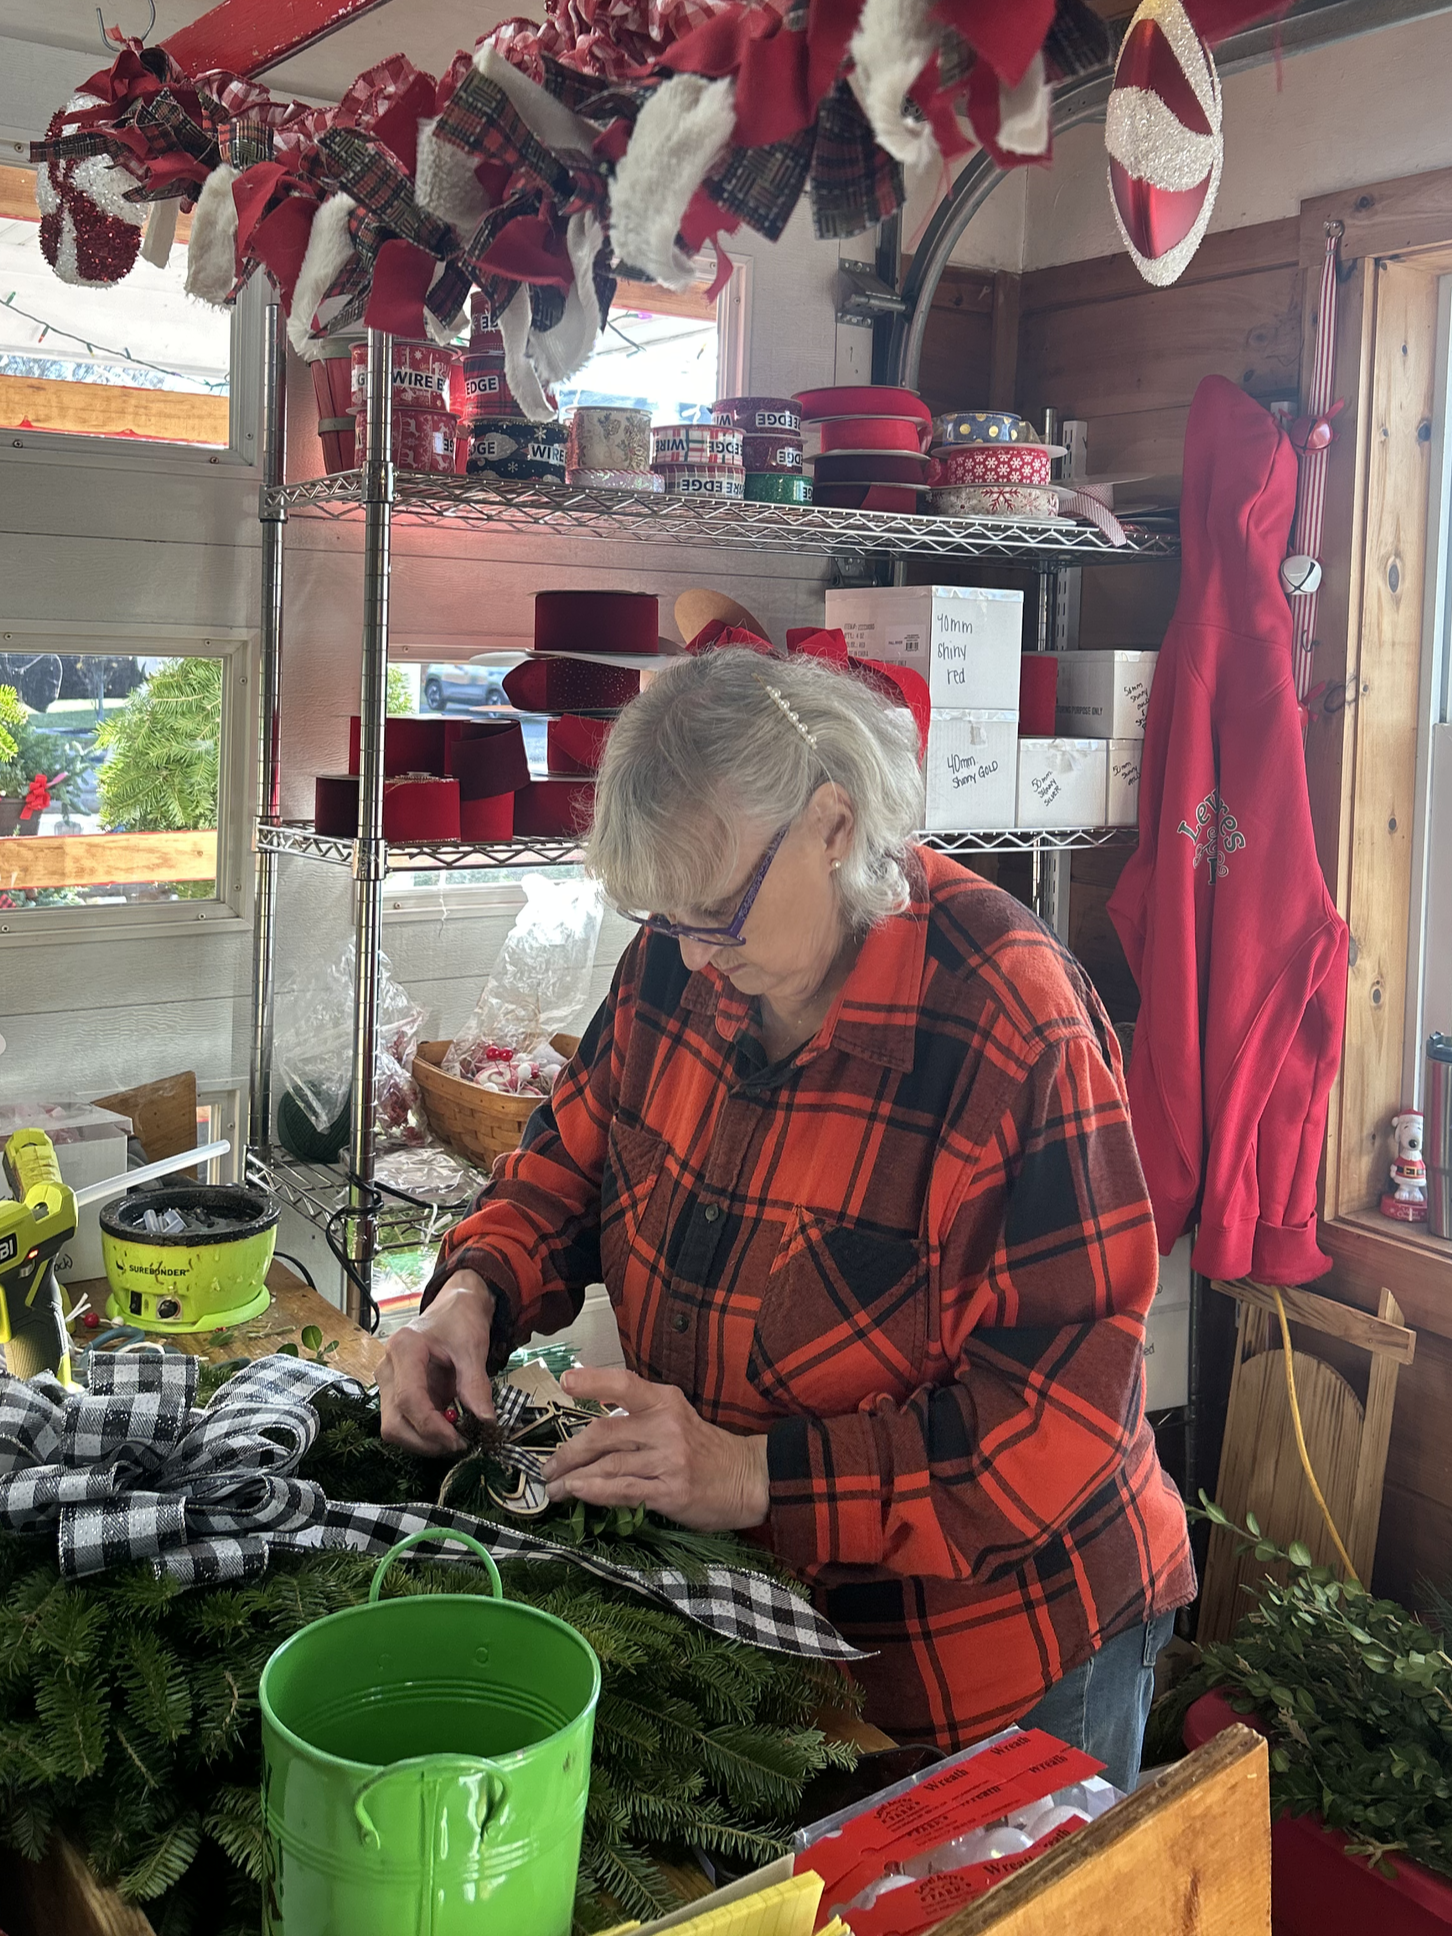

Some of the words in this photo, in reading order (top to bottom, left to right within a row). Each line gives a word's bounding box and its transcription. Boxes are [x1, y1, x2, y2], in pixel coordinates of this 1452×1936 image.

[393, 371, 433, 388] WIRE
[466, 377, 497, 395] EDGE
[757, 413, 793, 427] EDGE
[531, 445, 565, 463] WIRE
[681, 478, 723, 492] EDGE
[936, 613, 973, 634] 40mm
[947, 667, 966, 685] red
[978, 760, 999, 778] GOLD
[54, 1253, 73, 1271] ock)
[129, 1264, 188, 1277] SUREBONDER
[1143, 1342, 1155, 1356] ed
[990, 1736, 1031, 1756] Wreath
[1029, 1754, 1068, 1774] Wreath
[923, 1768, 969, 1792] Wreath
[1043, 1827, 1072, 1848] reath
